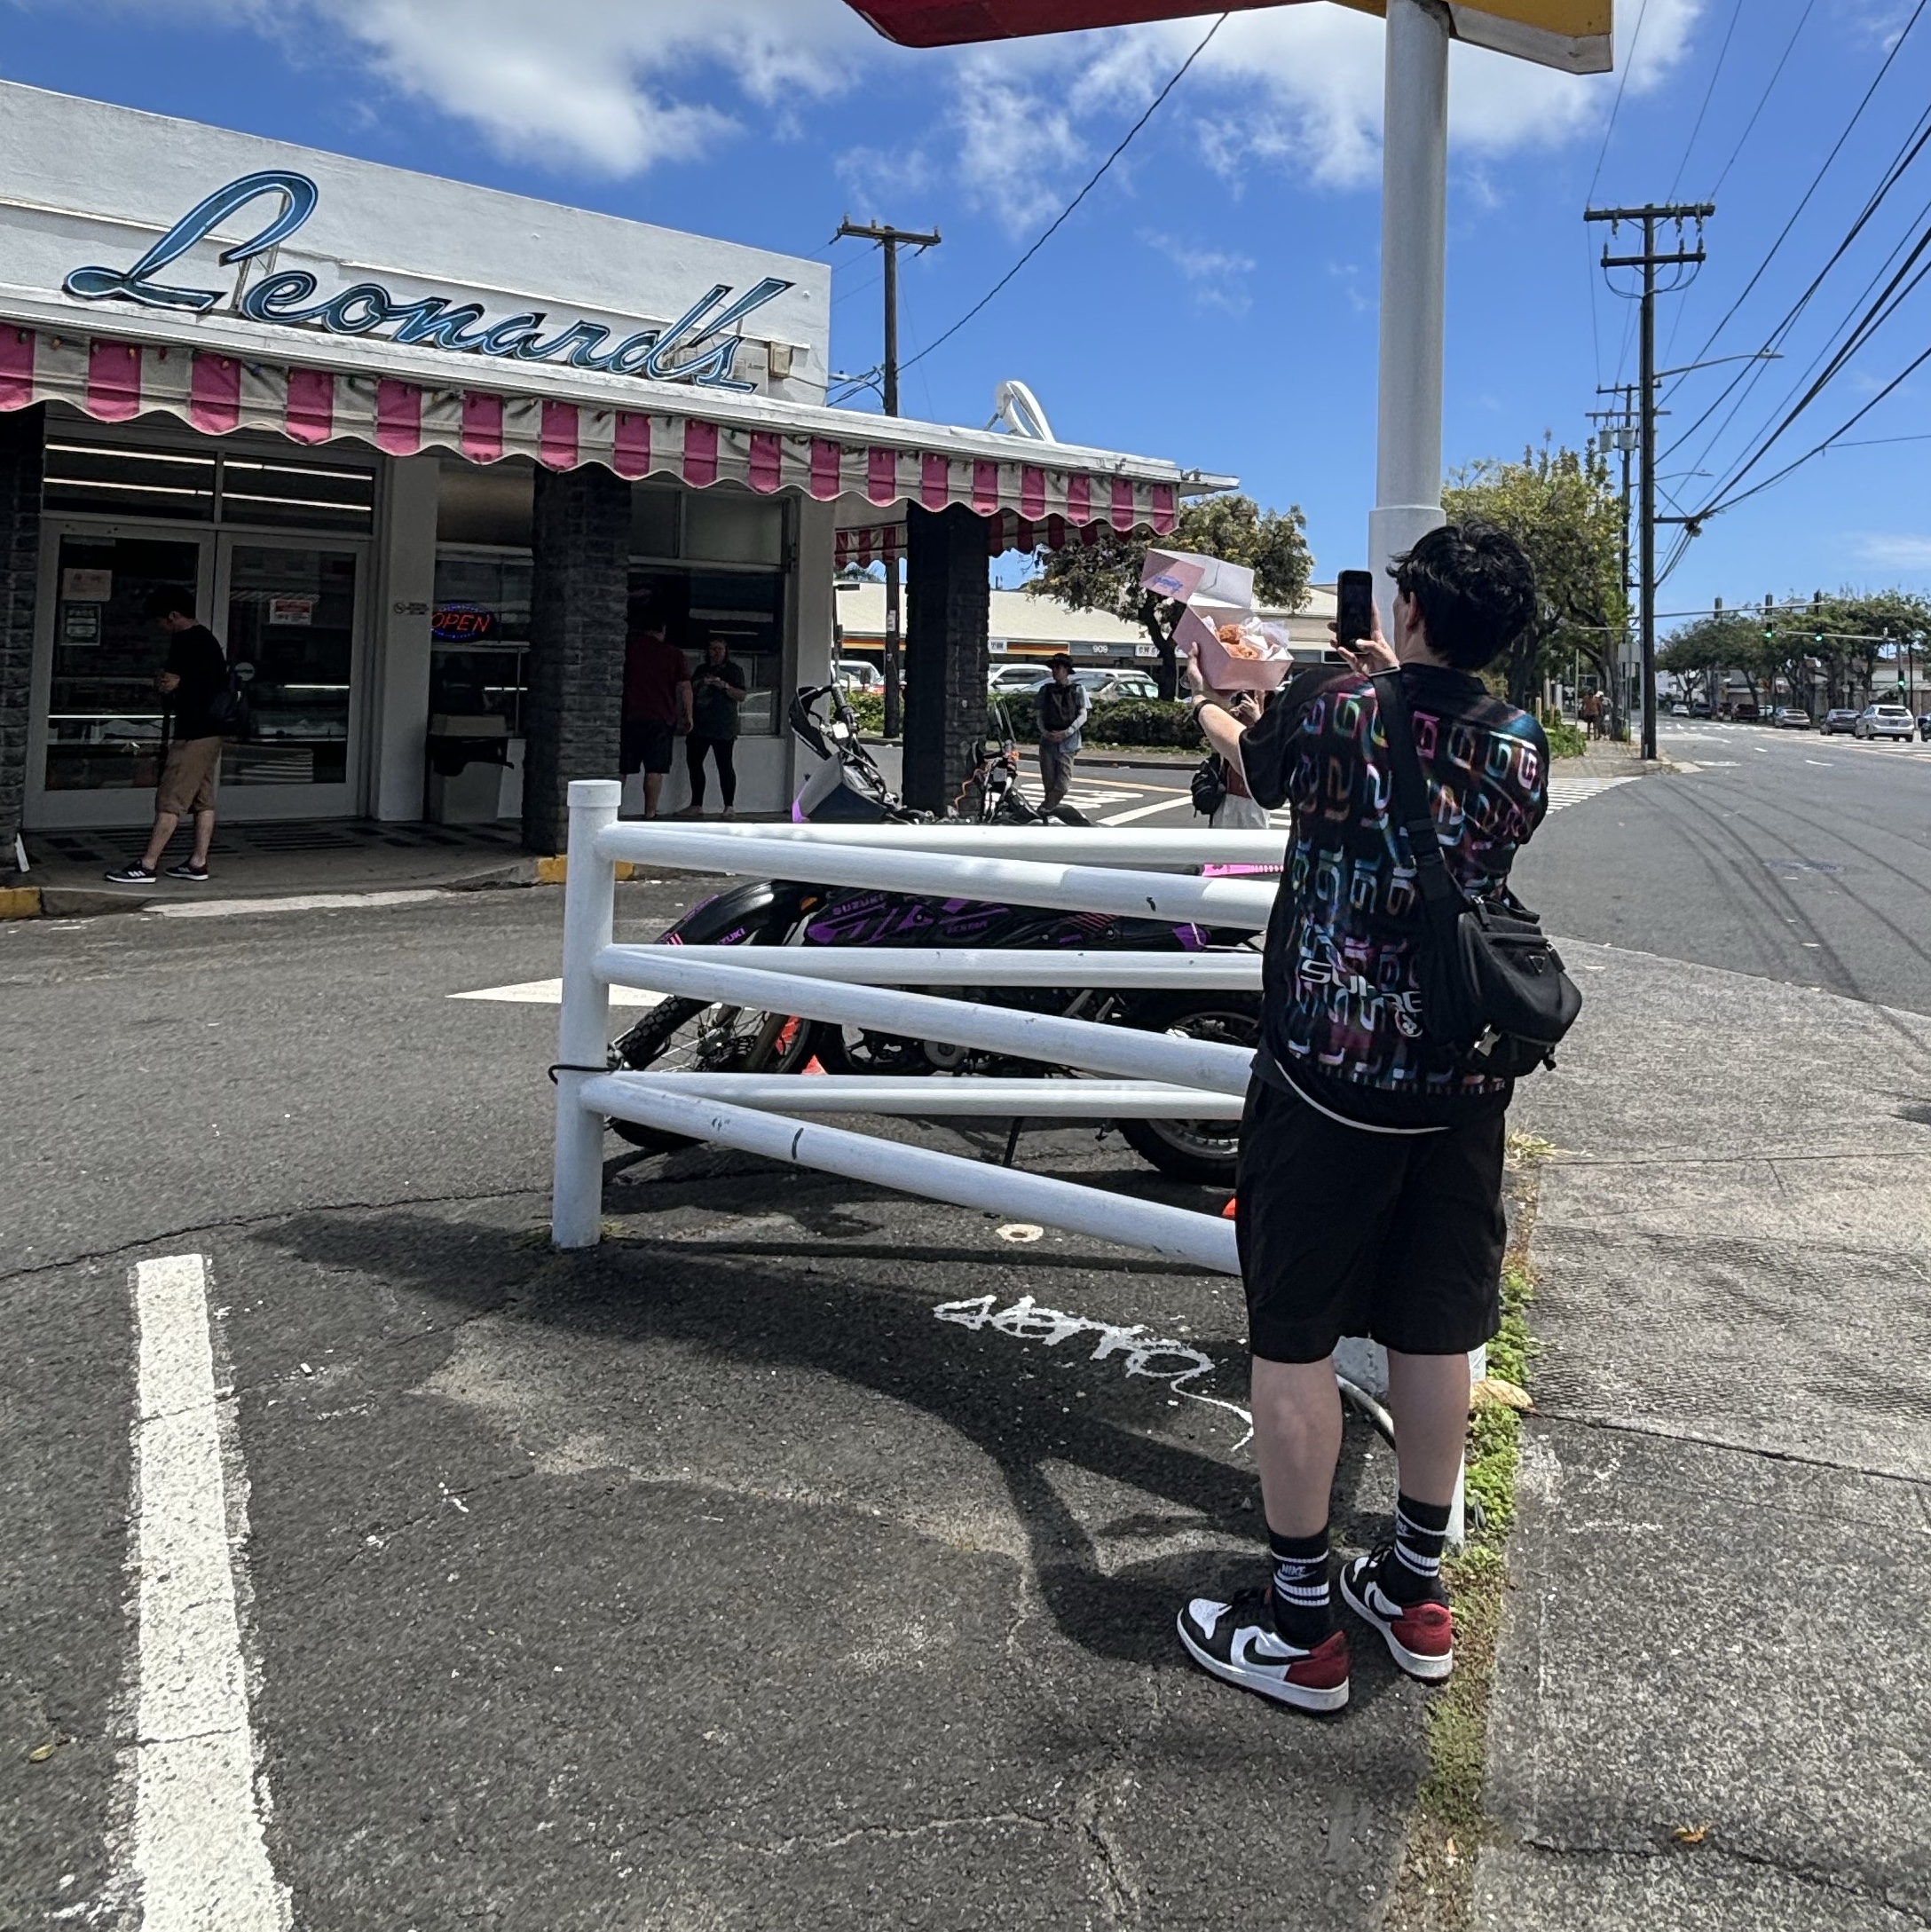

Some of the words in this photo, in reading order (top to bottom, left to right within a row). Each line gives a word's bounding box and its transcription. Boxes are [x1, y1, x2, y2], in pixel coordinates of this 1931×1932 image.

[62, 170, 796, 393] Leonard's
[431, 612, 491, 633] OPEN
[832, 894, 884, 915] SUZUKI
[1281, 1564, 1306, 1576] NIKE
